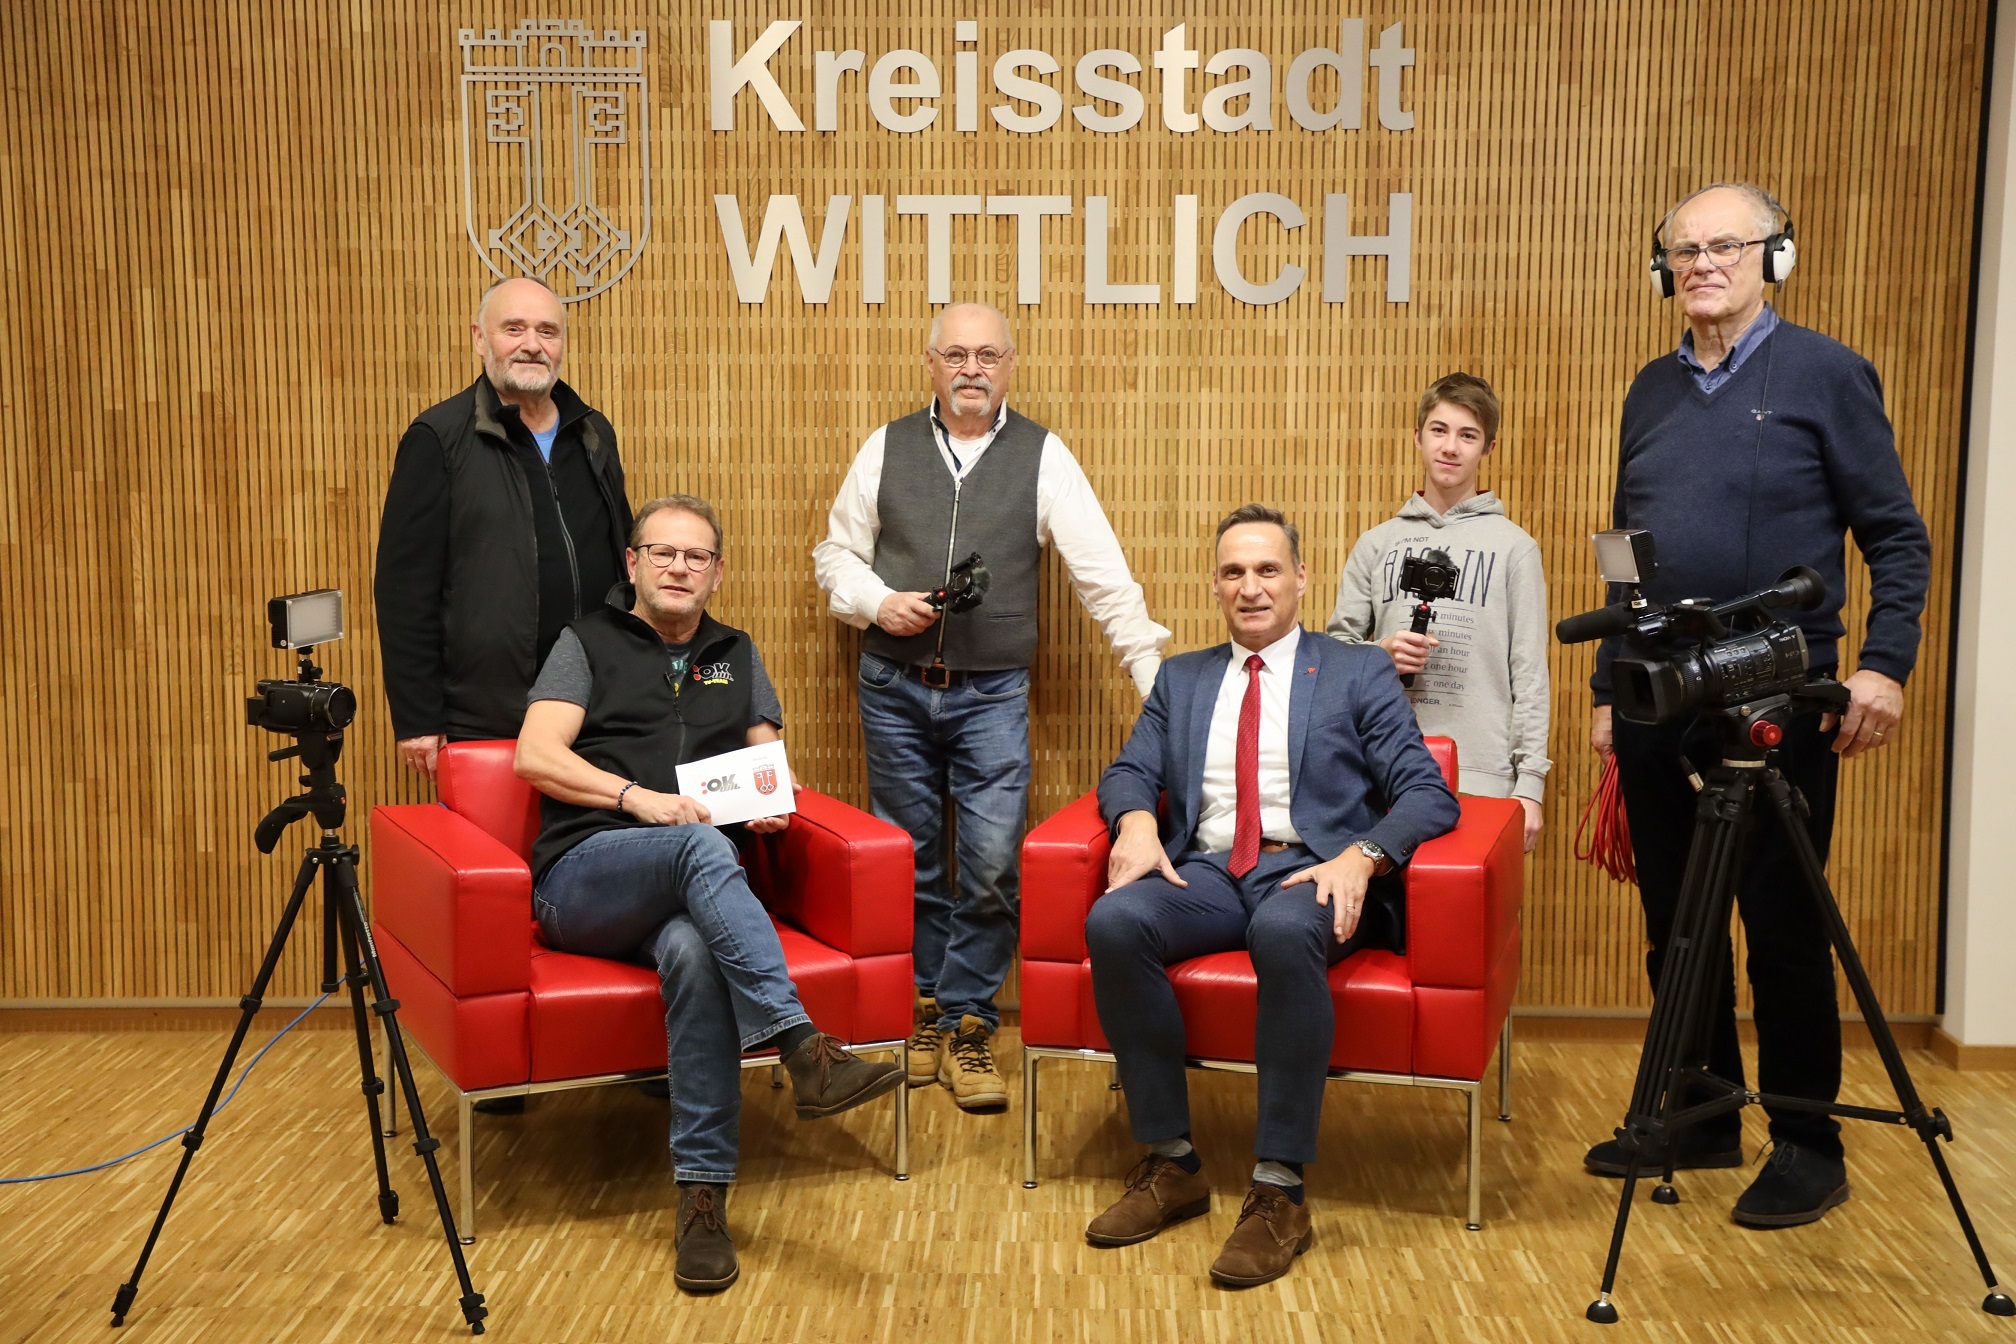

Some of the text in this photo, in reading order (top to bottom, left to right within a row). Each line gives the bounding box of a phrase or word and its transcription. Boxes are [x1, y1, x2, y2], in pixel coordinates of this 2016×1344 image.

[709, 18, 1415, 133] Kreisstadt
[715, 192, 1412, 305] WITTLICH
[1455, 549, 1495, 607] IN
[1440, 612, 1475, 625] minutes
[1438, 628, 1472, 641] minutes
[1450, 646, 1470, 657] hour
[1430, 663, 1447, 671] one
[1448, 663, 1469, 674] hour
[1433, 680, 1450, 688] one
[1450, 681, 1465, 691] day
